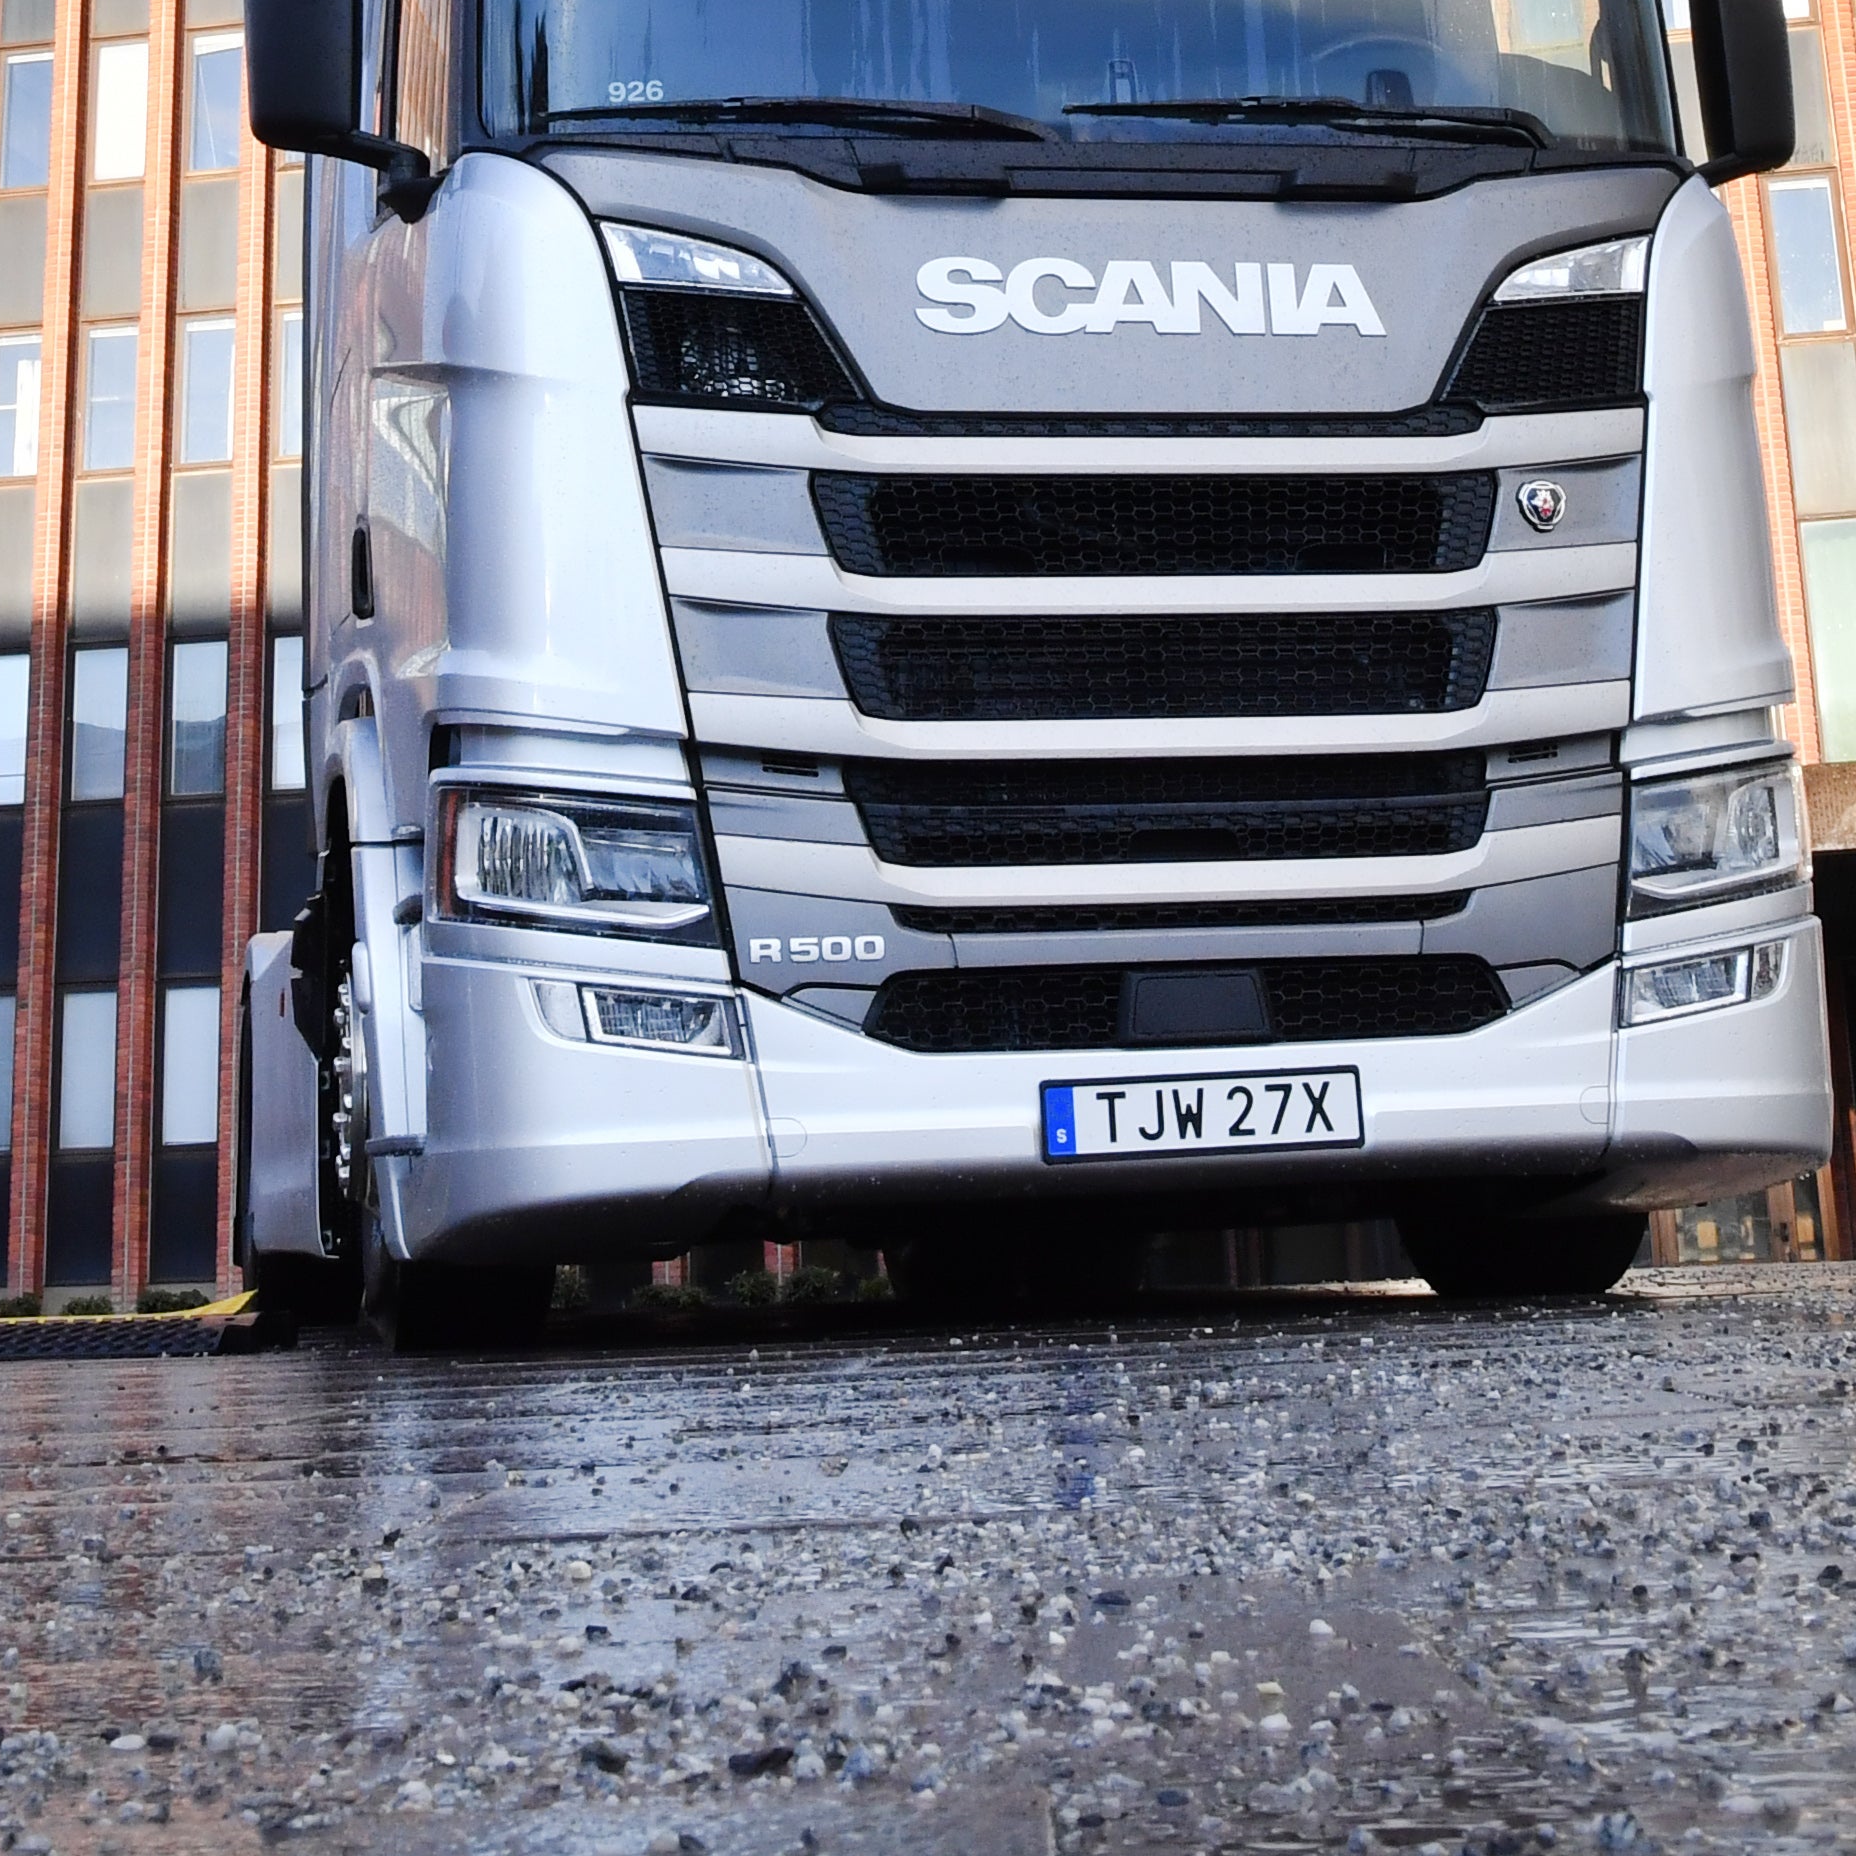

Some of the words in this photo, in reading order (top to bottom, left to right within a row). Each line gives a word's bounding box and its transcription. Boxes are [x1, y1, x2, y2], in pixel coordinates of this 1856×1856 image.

[608, 79, 664, 103] 926
[915, 256, 1388, 337] SCANIA
[749, 938, 783, 964] R
[789, 935, 886, 964] 500
[1096, 1087, 1205, 1143] TJW
[1226, 1081, 1335, 1137] 27X
[1056, 1128, 1068, 1144] S
